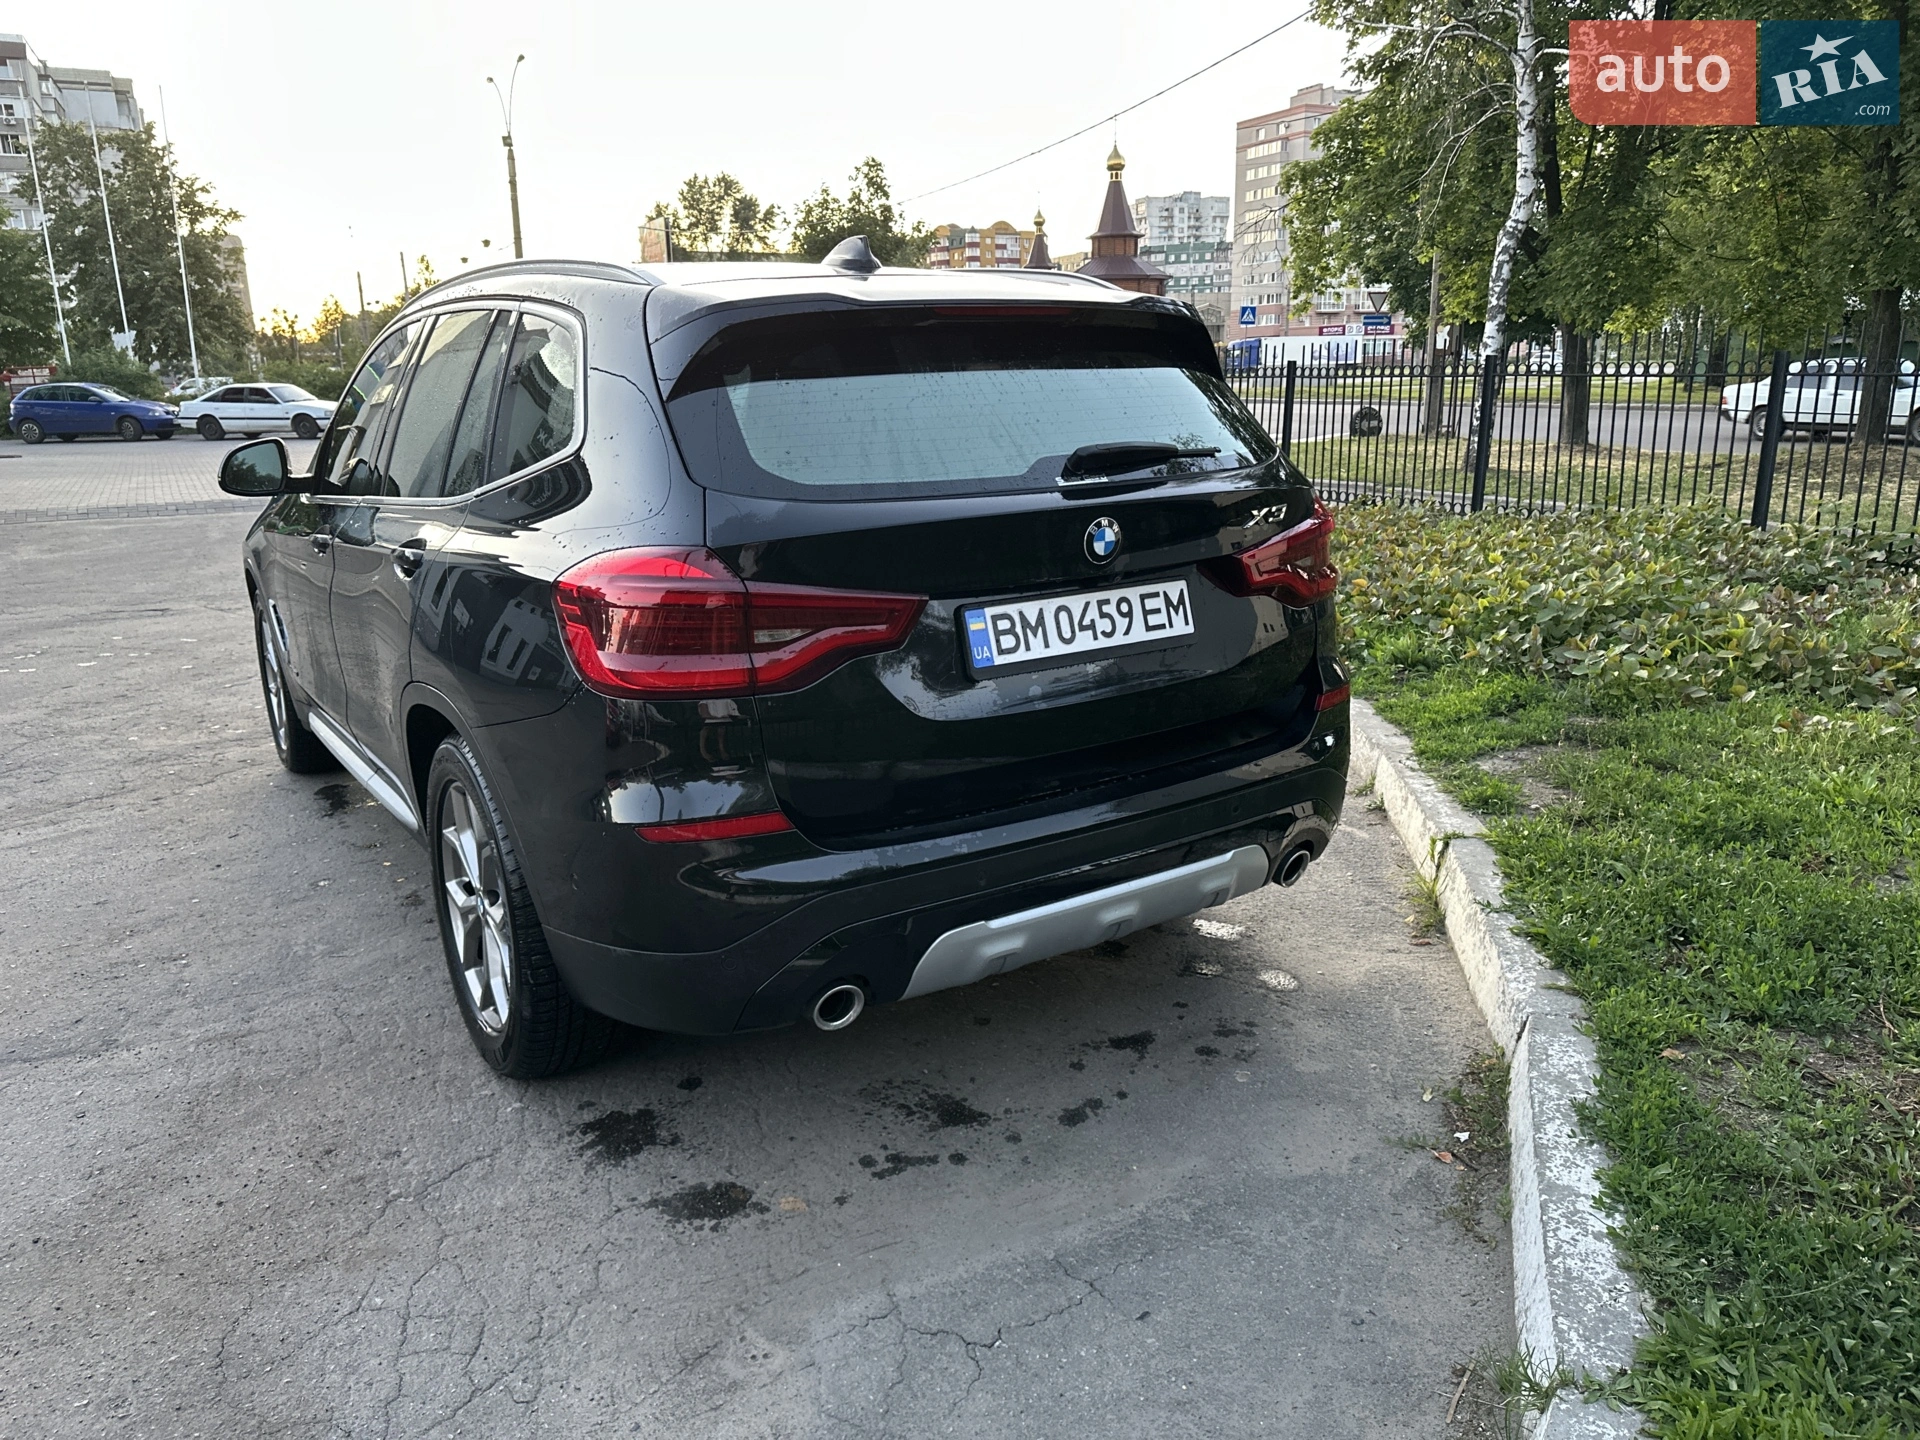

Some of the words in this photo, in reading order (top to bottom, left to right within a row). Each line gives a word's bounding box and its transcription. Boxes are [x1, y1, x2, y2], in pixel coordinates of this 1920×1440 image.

[1242, 503, 1287, 529] X3
[1089, 519, 1119, 535] BMW
[991, 607, 1050, 656] BM
[1054, 596, 1134, 645] 0459
[1138, 588, 1190, 632] EM
[974, 647, 991, 660] UA
